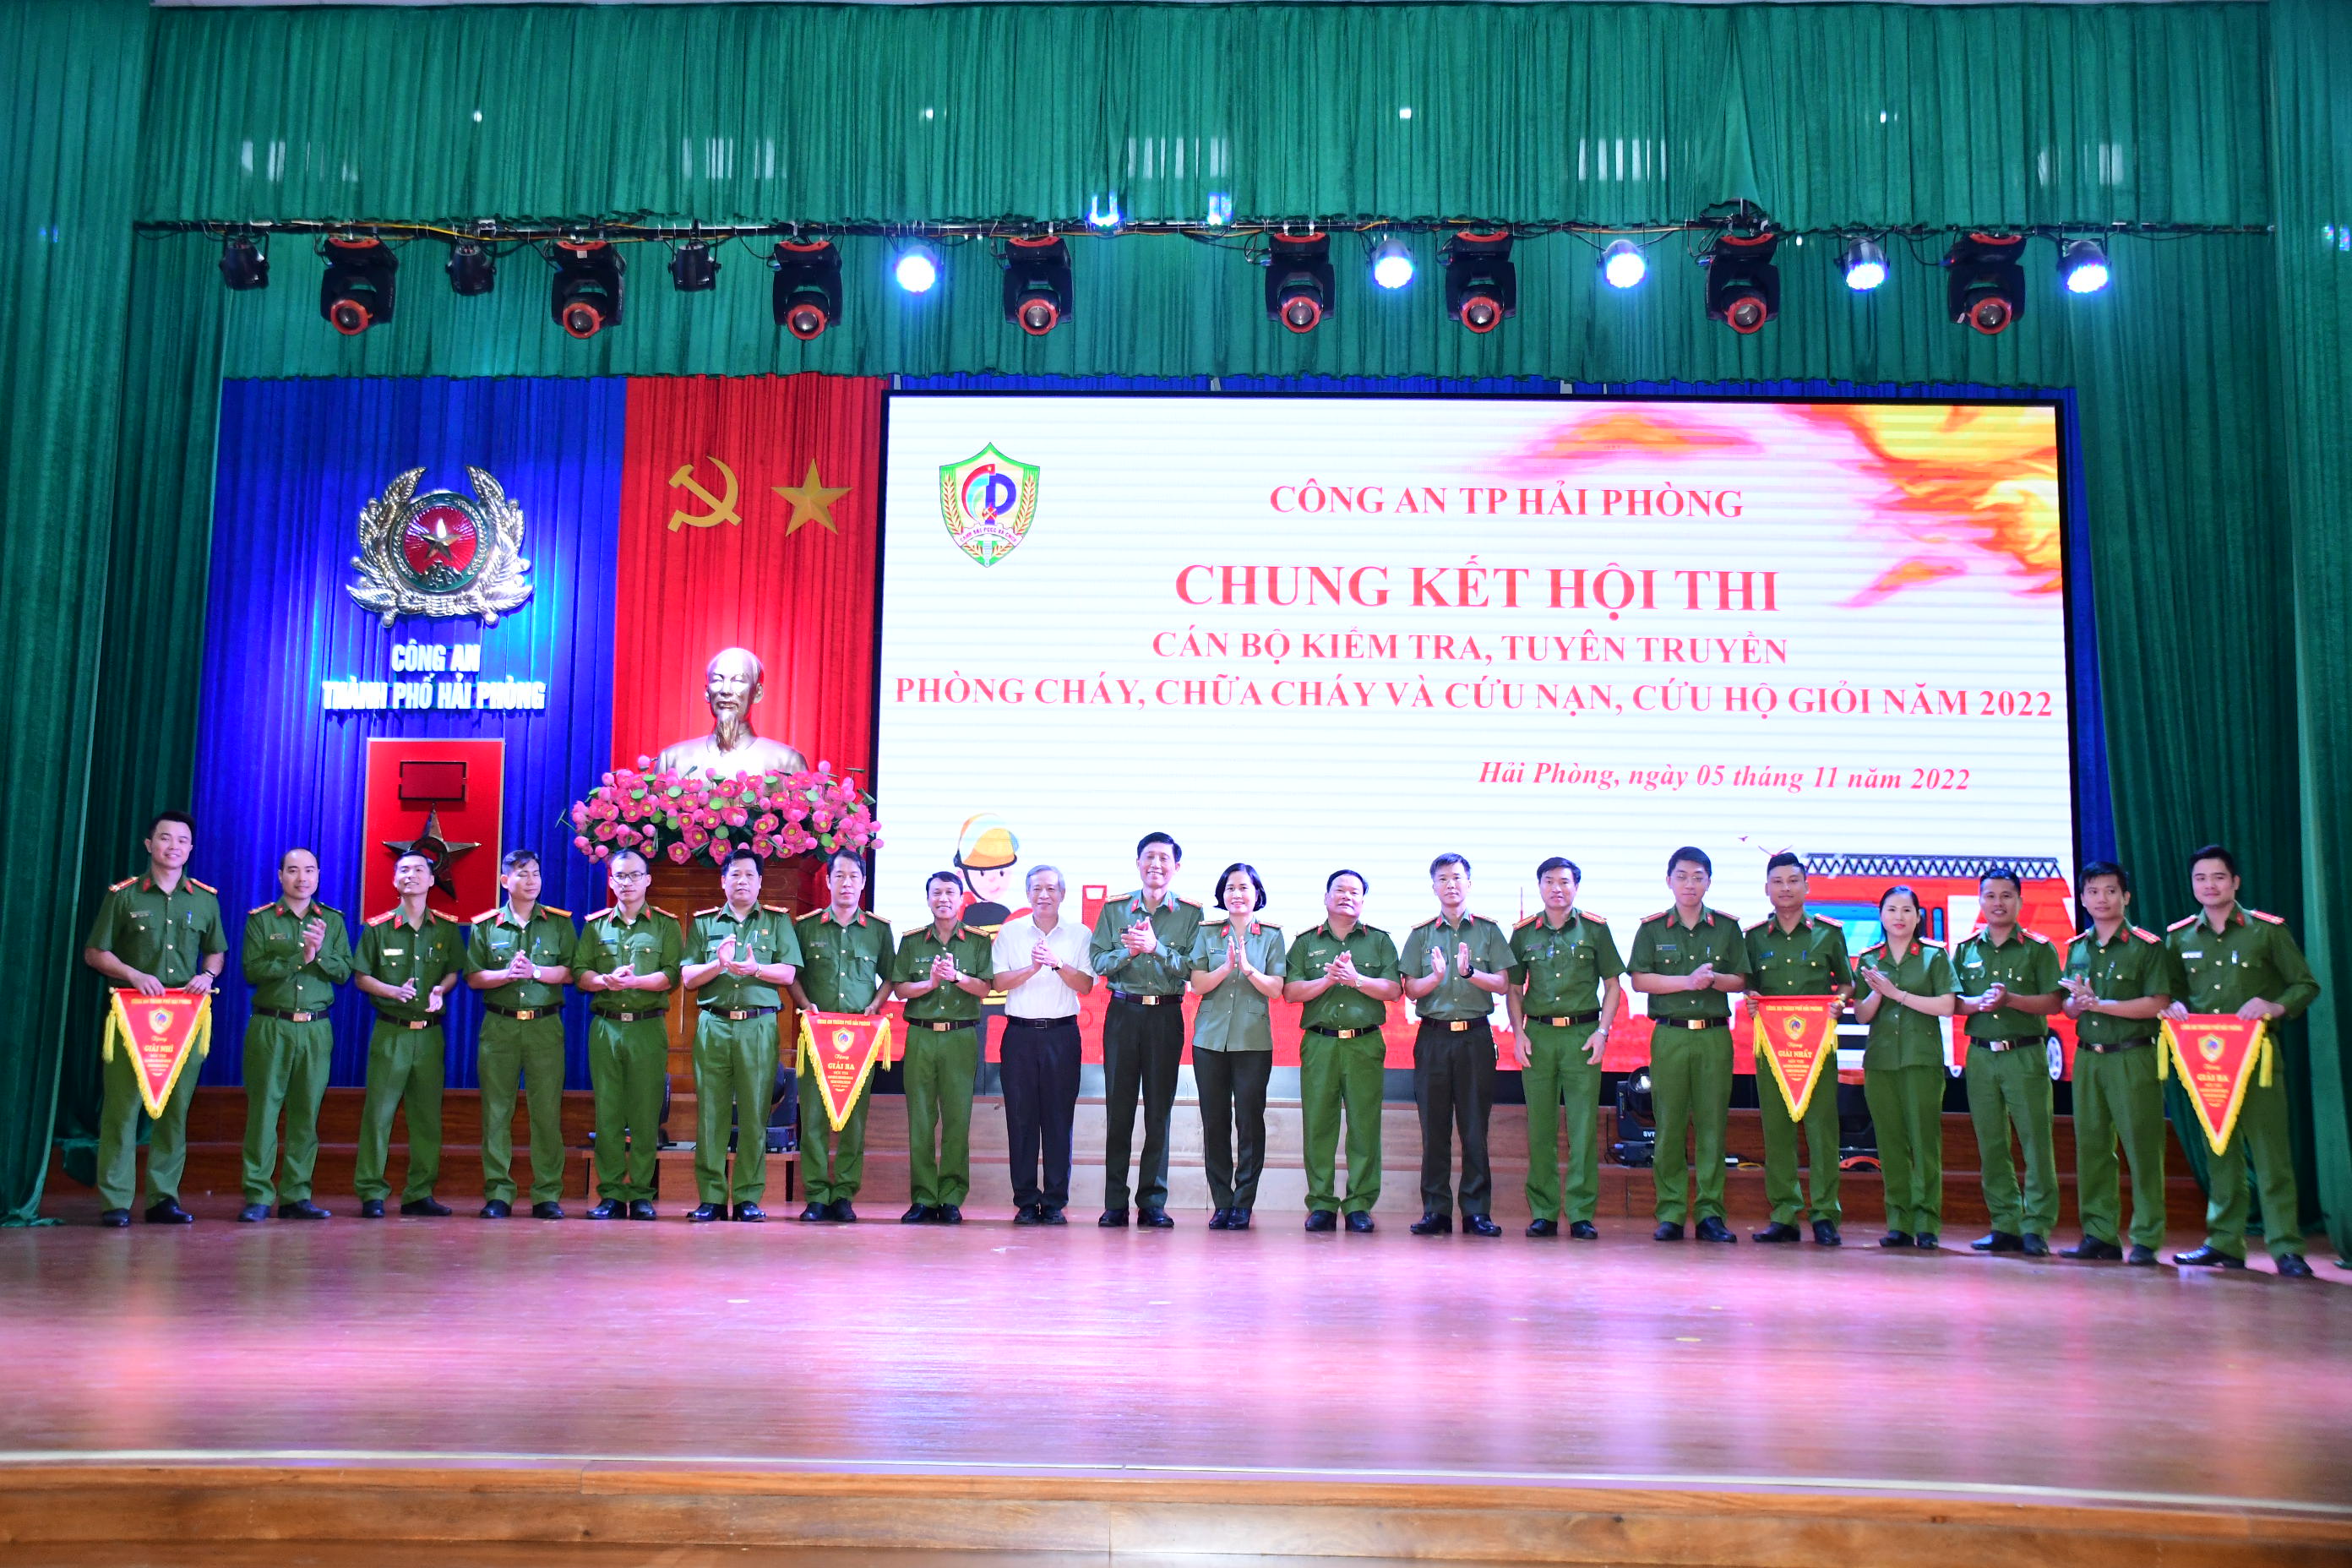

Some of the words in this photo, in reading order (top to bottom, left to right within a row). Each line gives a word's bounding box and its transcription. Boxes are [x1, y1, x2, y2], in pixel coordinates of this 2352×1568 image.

[1270, 478, 1384, 514] CÔNG
[1395, 487, 1446, 514] AN
[1459, 487, 1508, 515] TP
[1517, 480, 1587, 516] HẢI
[1602, 482, 1744, 518] PHÒNG
[1175, 564, 1390, 607] CHUNG
[1409, 554, 1529, 607] KẾT
[1547, 562, 1658, 621] HỘI
[1674, 569, 1779, 612] THI
[391, 639, 446, 672] CÔNG
[450, 644, 481, 672] AN
[1153, 623, 1228, 657] CÁN
[1241, 629, 1290, 666] BỘ
[1408, 634, 1492, 665] TRA,
[1501, 629, 1625, 662] TUYÊN
[1636, 630, 1788, 664] TRUYỀN
[322, 675, 388, 710] THÀNH
[392, 673, 435, 710] PHỐ
[437, 672, 472, 710] HẢI
[476, 675, 547, 710] PHÒNG
[896, 671, 1026, 704] PHÒNG
[1035, 672, 1145, 709] CHÁY,
[1156, 673, 1263, 705] CHỮA
[1271, 673, 1377, 707] CHÁY
[1386, 674, 1435, 707] VÀ
[1446, 676, 1524, 709] CỨU
[1536, 683, 1622, 717] NẠN,
[1633, 678, 1712, 711] CỨU
[1724, 683, 1778, 720] HỘ
[1788, 680, 1870, 714] GIỎI
[1883, 682, 1968, 716] NĂM
[1980, 691, 2052, 717] 2022
[1478, 761, 1526, 784] Hải
[1533, 763, 1620, 791] Phòng,
[1629, 764, 1689, 792] ngày
[1696, 764, 1725, 787] 05
[1734, 765, 1804, 793] tháng
[1814, 765, 1838, 787] 11
[1848, 767, 1902, 789] năm
[1910, 767, 1970, 790] 2022
